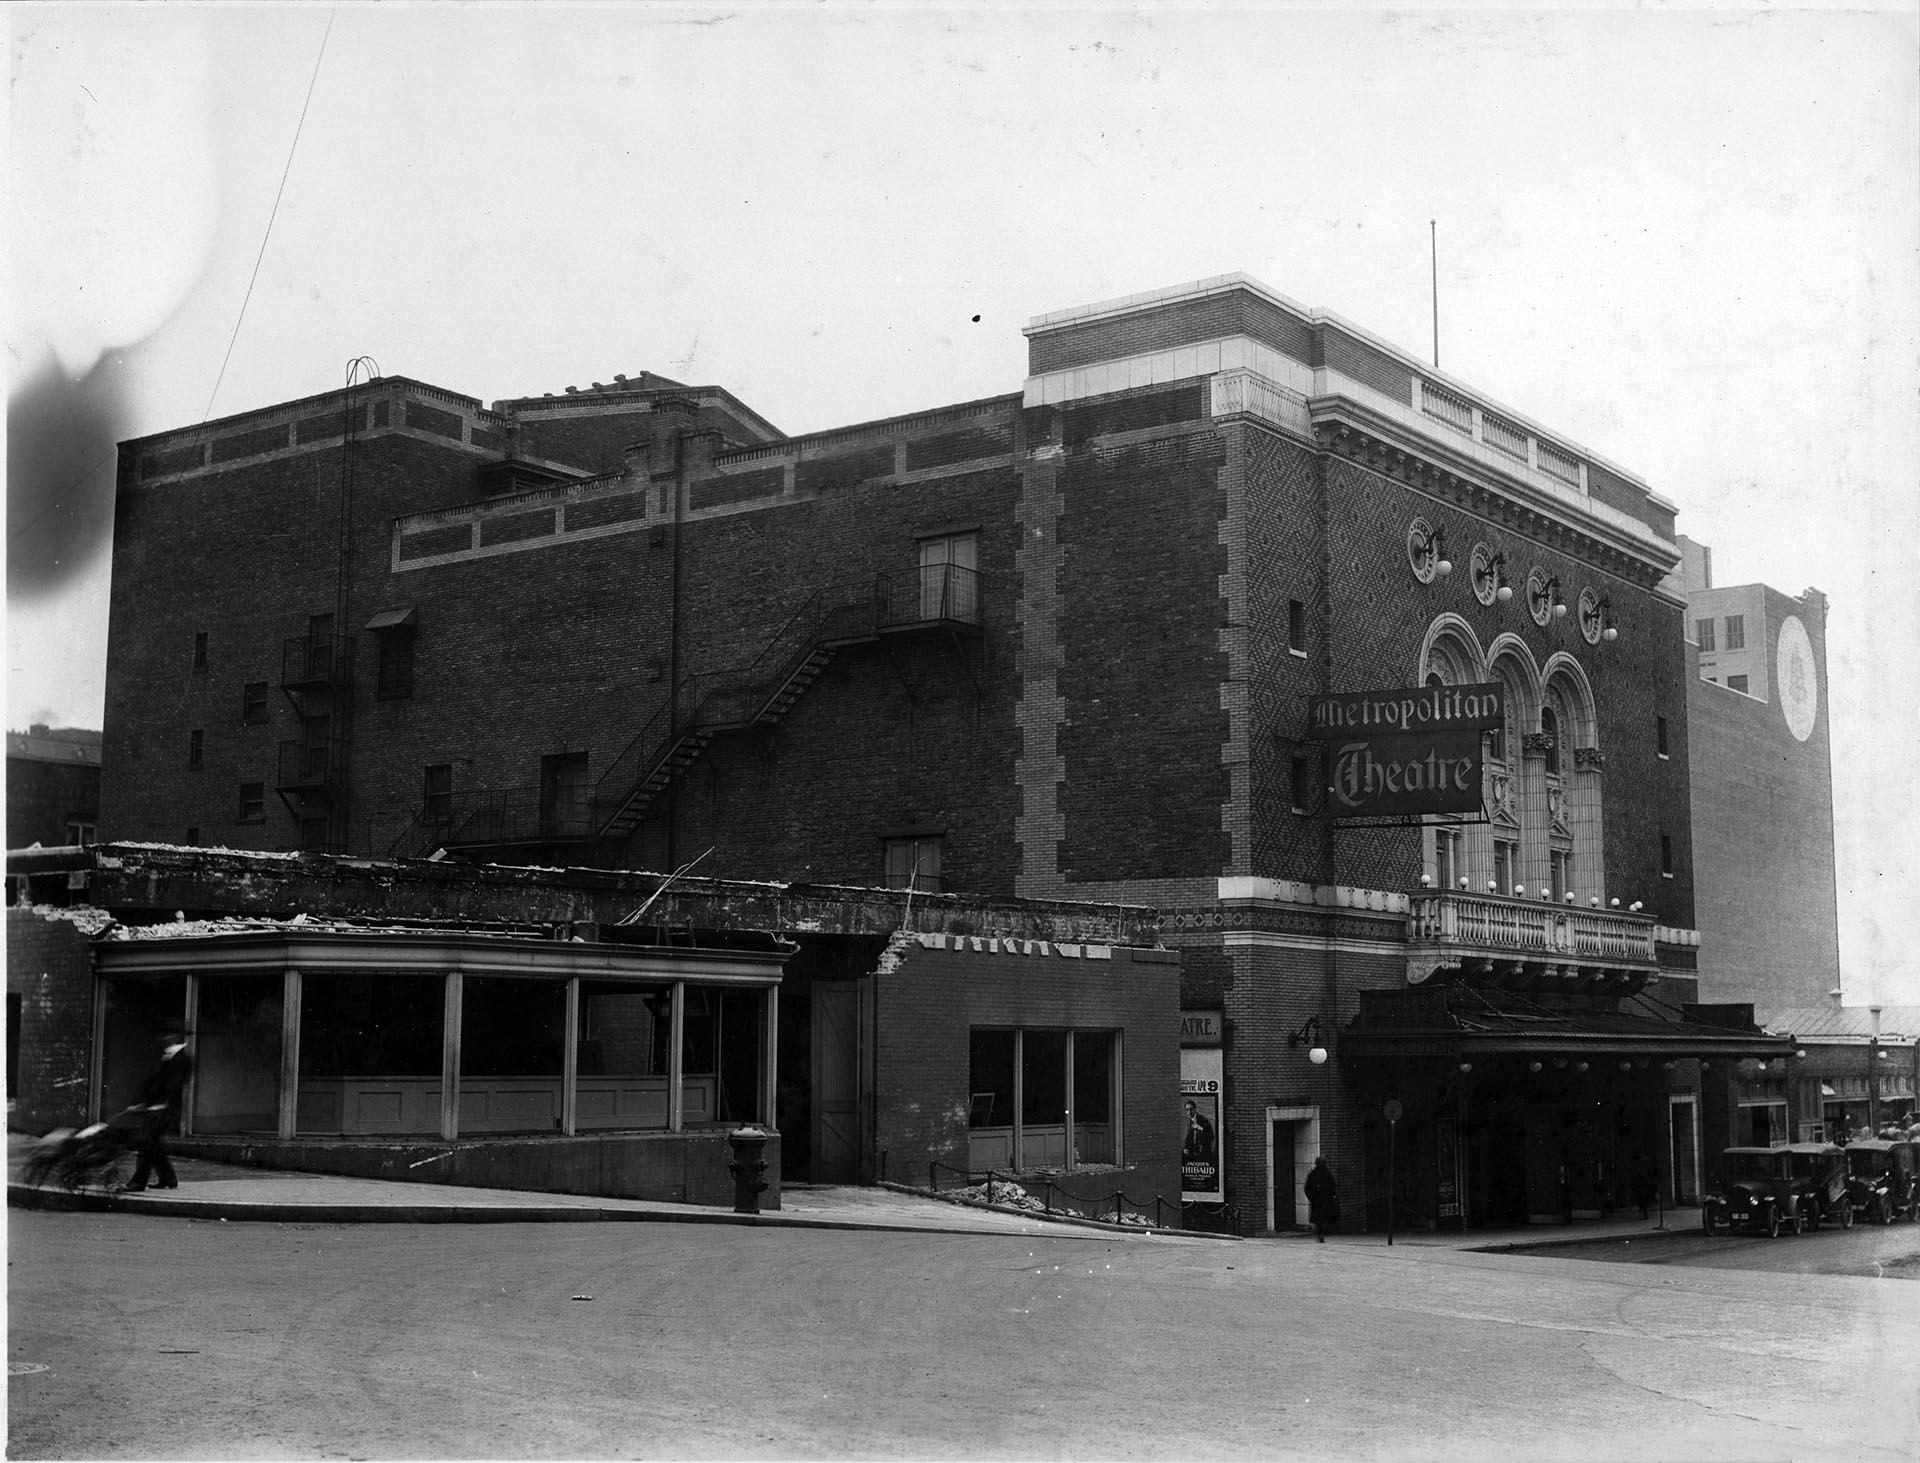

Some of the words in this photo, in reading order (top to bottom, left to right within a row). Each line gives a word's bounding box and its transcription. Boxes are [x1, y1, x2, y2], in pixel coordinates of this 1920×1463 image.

[1315, 691, 1498, 729] Metropolitan
[1334, 741, 1473, 807] Theatre
[1208, 1080, 1218, 1092] 9
